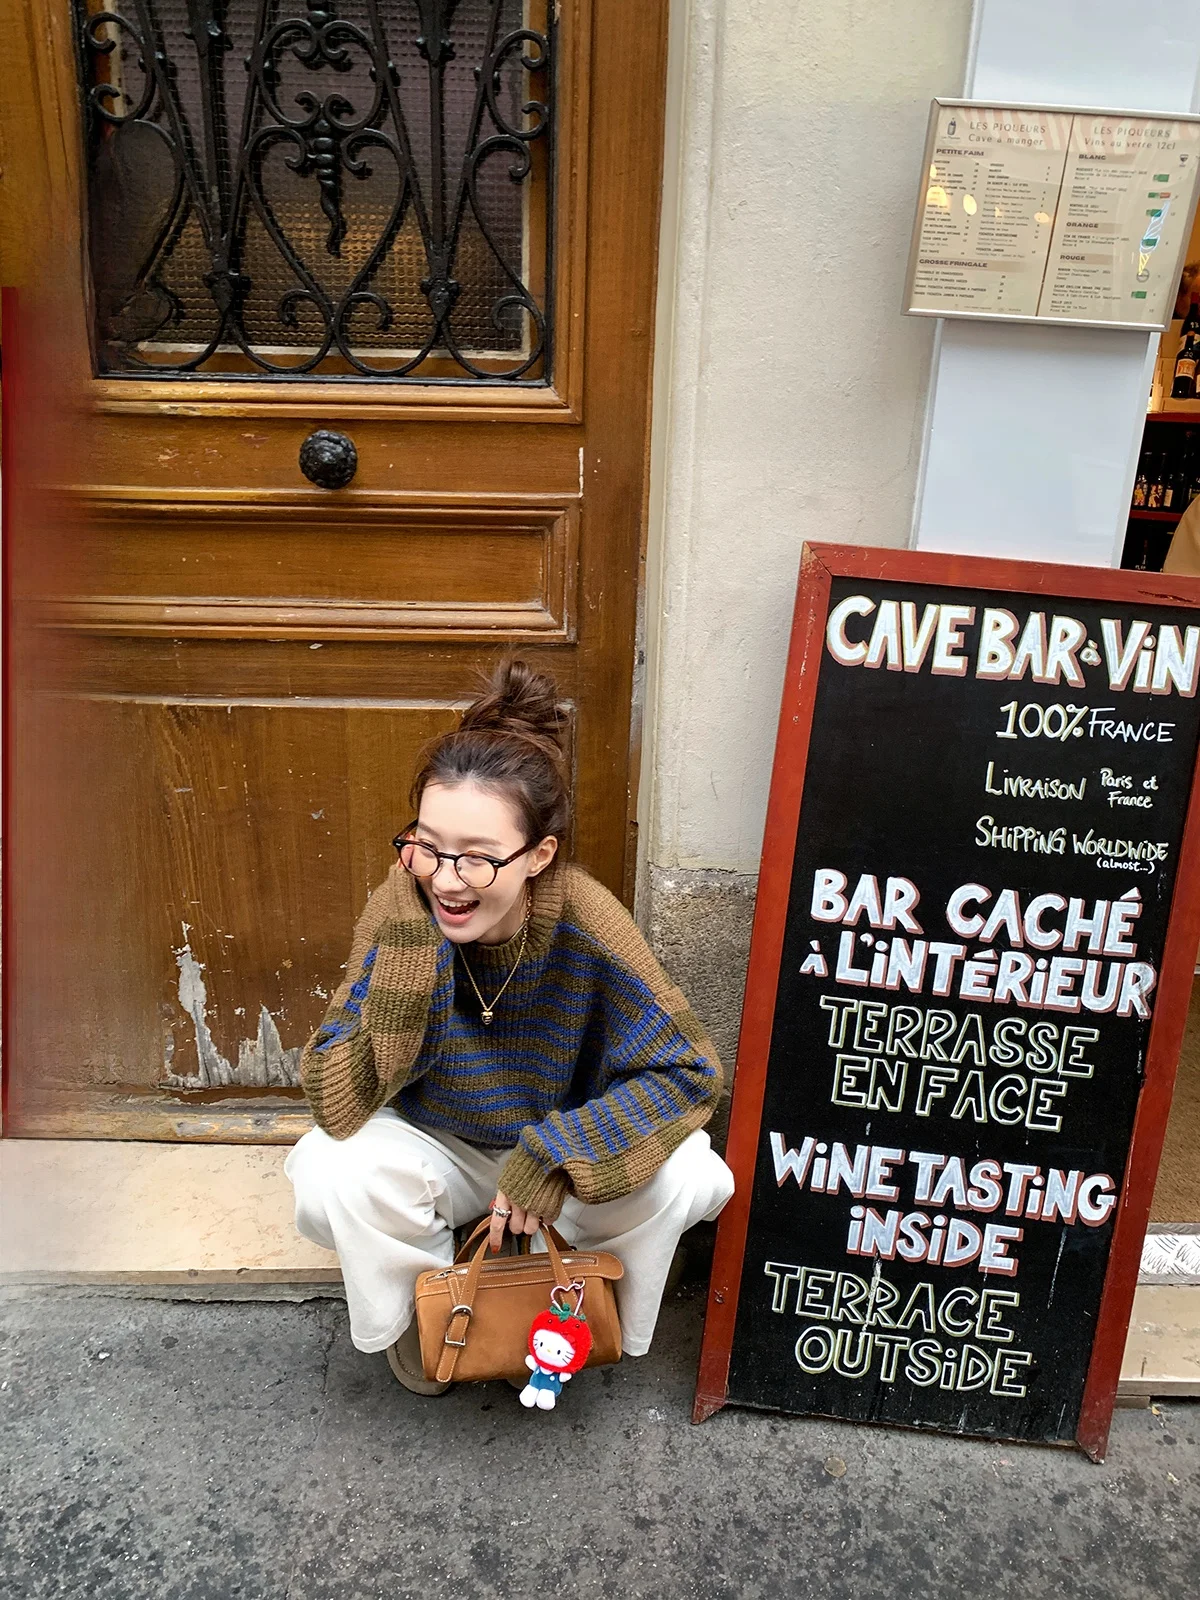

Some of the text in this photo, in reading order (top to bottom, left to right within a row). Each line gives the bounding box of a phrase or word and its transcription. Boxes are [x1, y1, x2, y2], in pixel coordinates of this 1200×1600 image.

[826, 595, 976, 677] CAVE
[975, 607, 1086, 688] BAR
[995, 701, 1176, 743] 100% FRANCE
[1100, 767, 1133, 790] Paris
[1143, 775, 1159, 791] et
[1107, 790, 1153, 808] France
[810, 868, 1143, 957] BAR CACHÉ
[819, 995, 1100, 1078] TERRASSE
[831, 1053, 1068, 1132] EN FACE
[764, 1261, 1020, 1342] TERRACE
